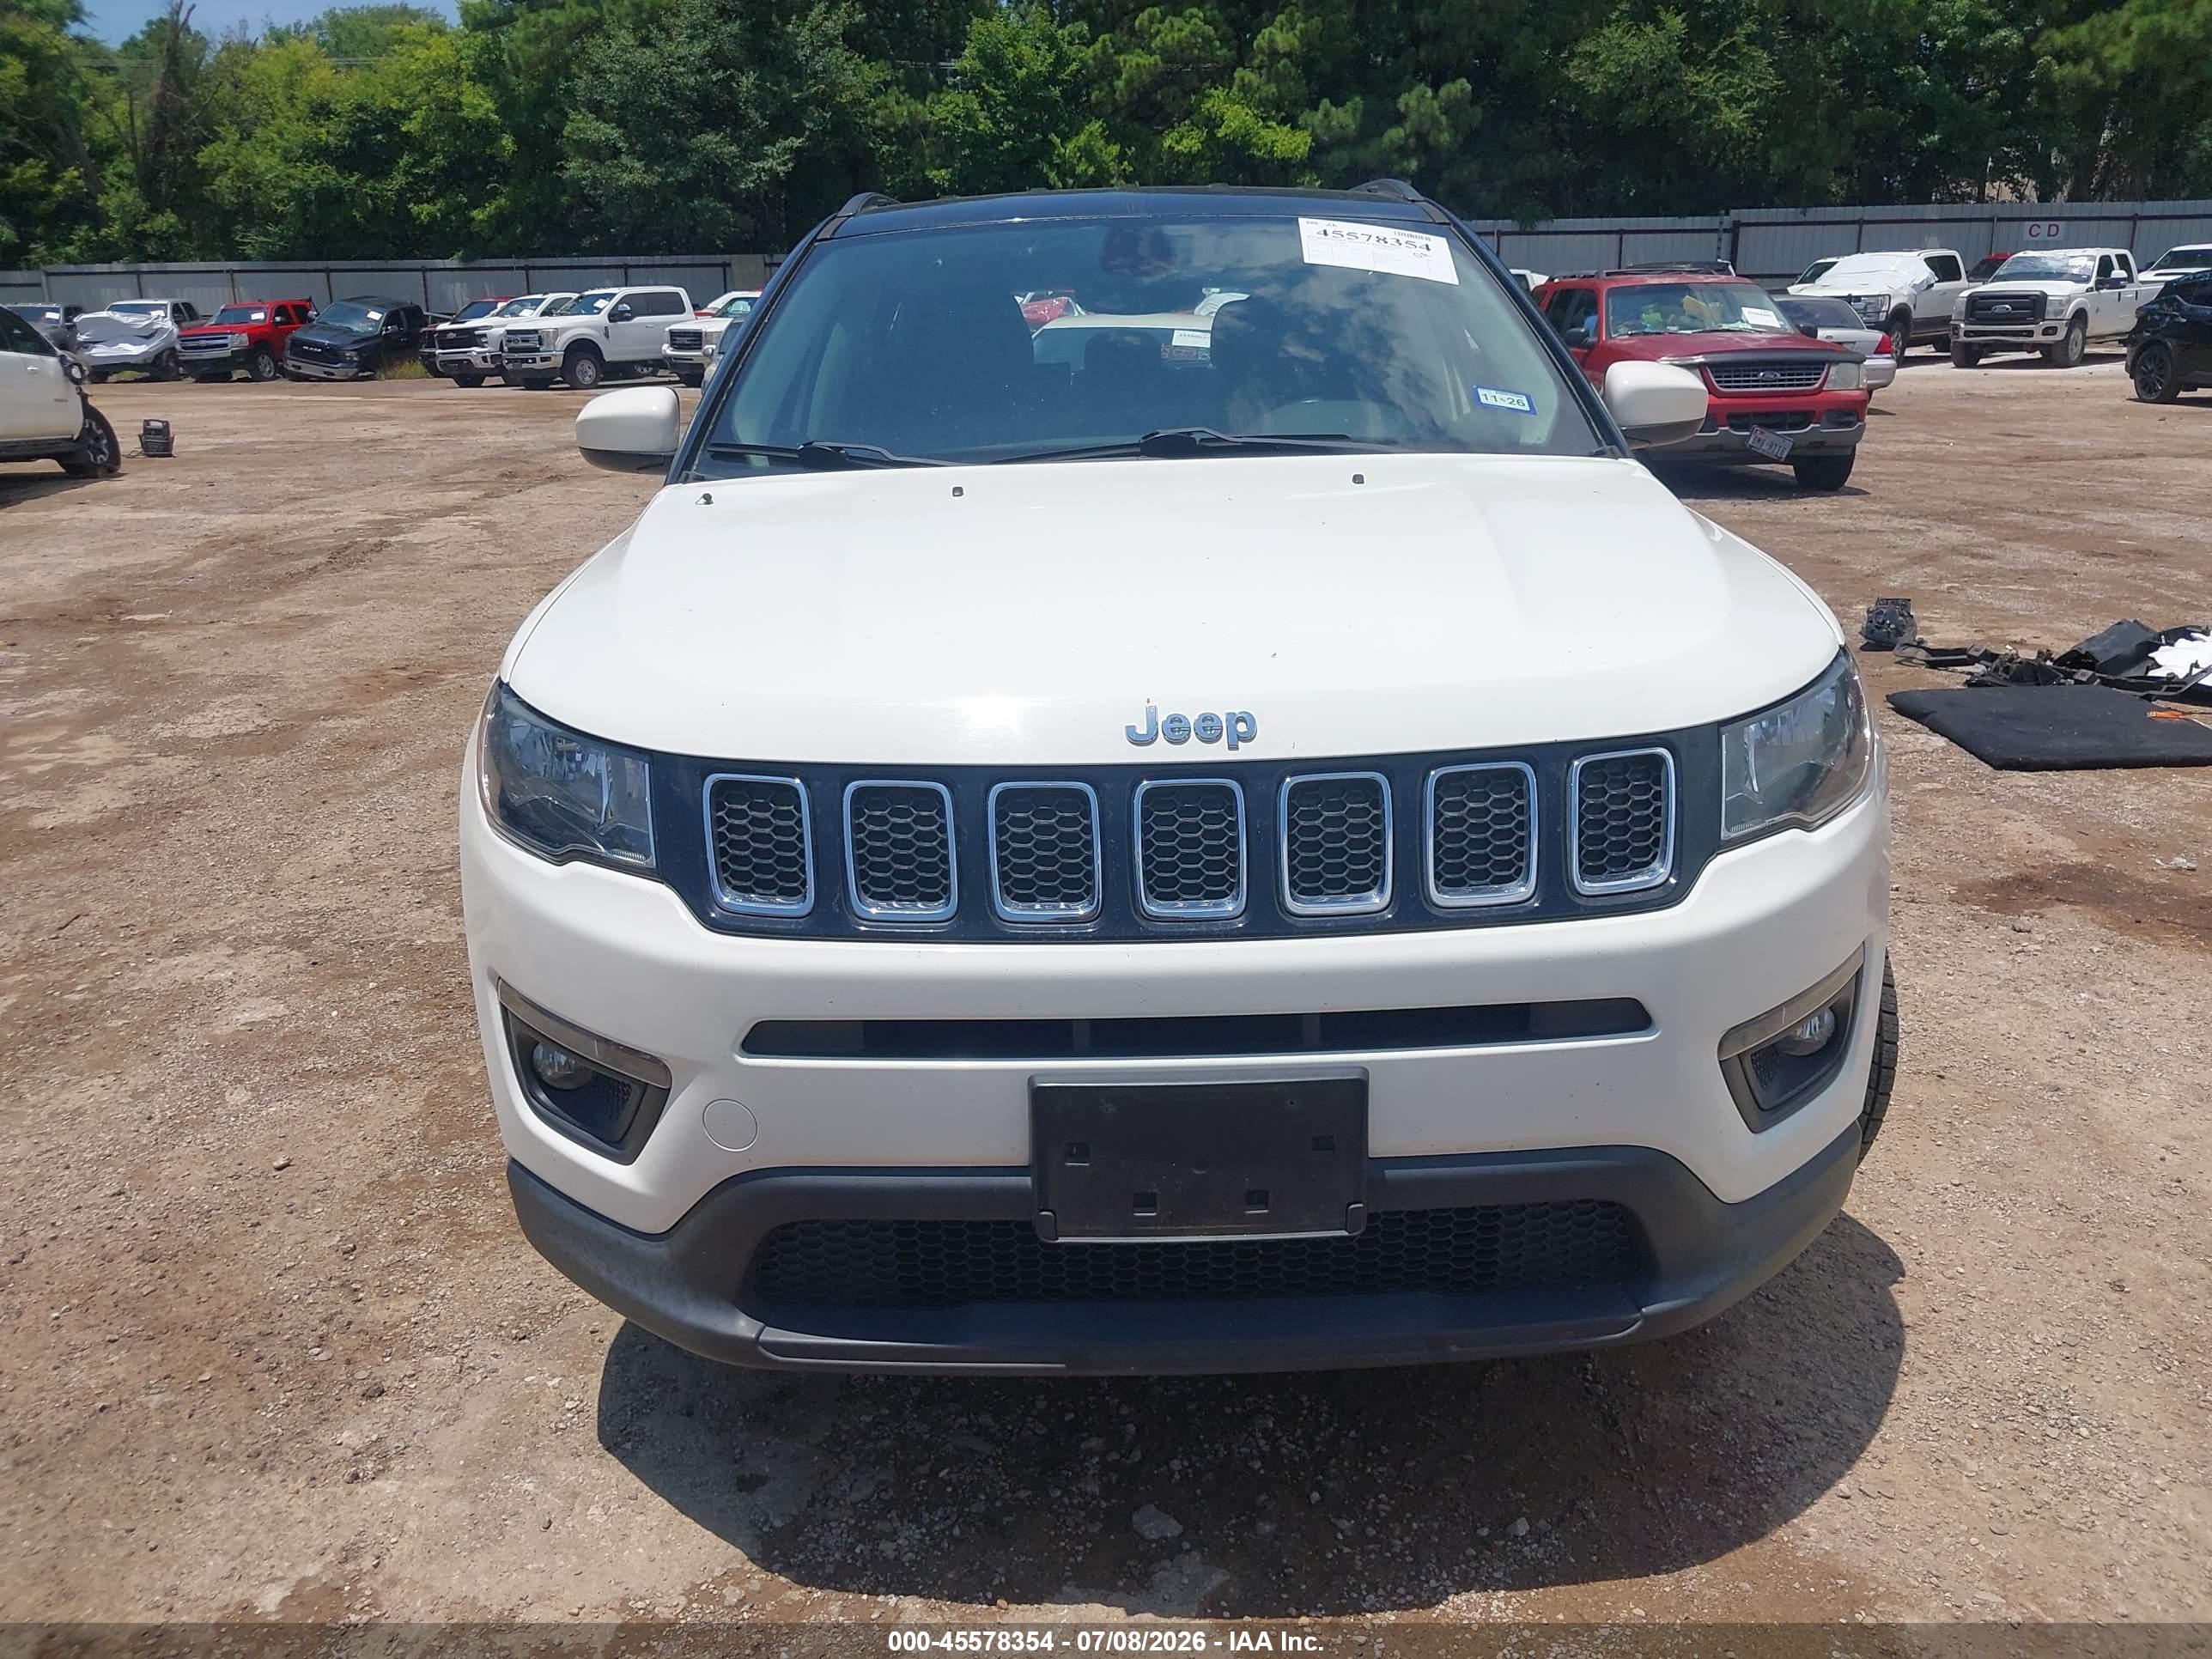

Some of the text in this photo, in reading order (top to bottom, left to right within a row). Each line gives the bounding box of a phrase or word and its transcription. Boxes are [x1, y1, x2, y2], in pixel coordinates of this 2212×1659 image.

[1316, 228, 1431, 252] 45578354
[1481, 393, 1526, 407] 11-26
[1125, 705, 1257, 750] Jeep
